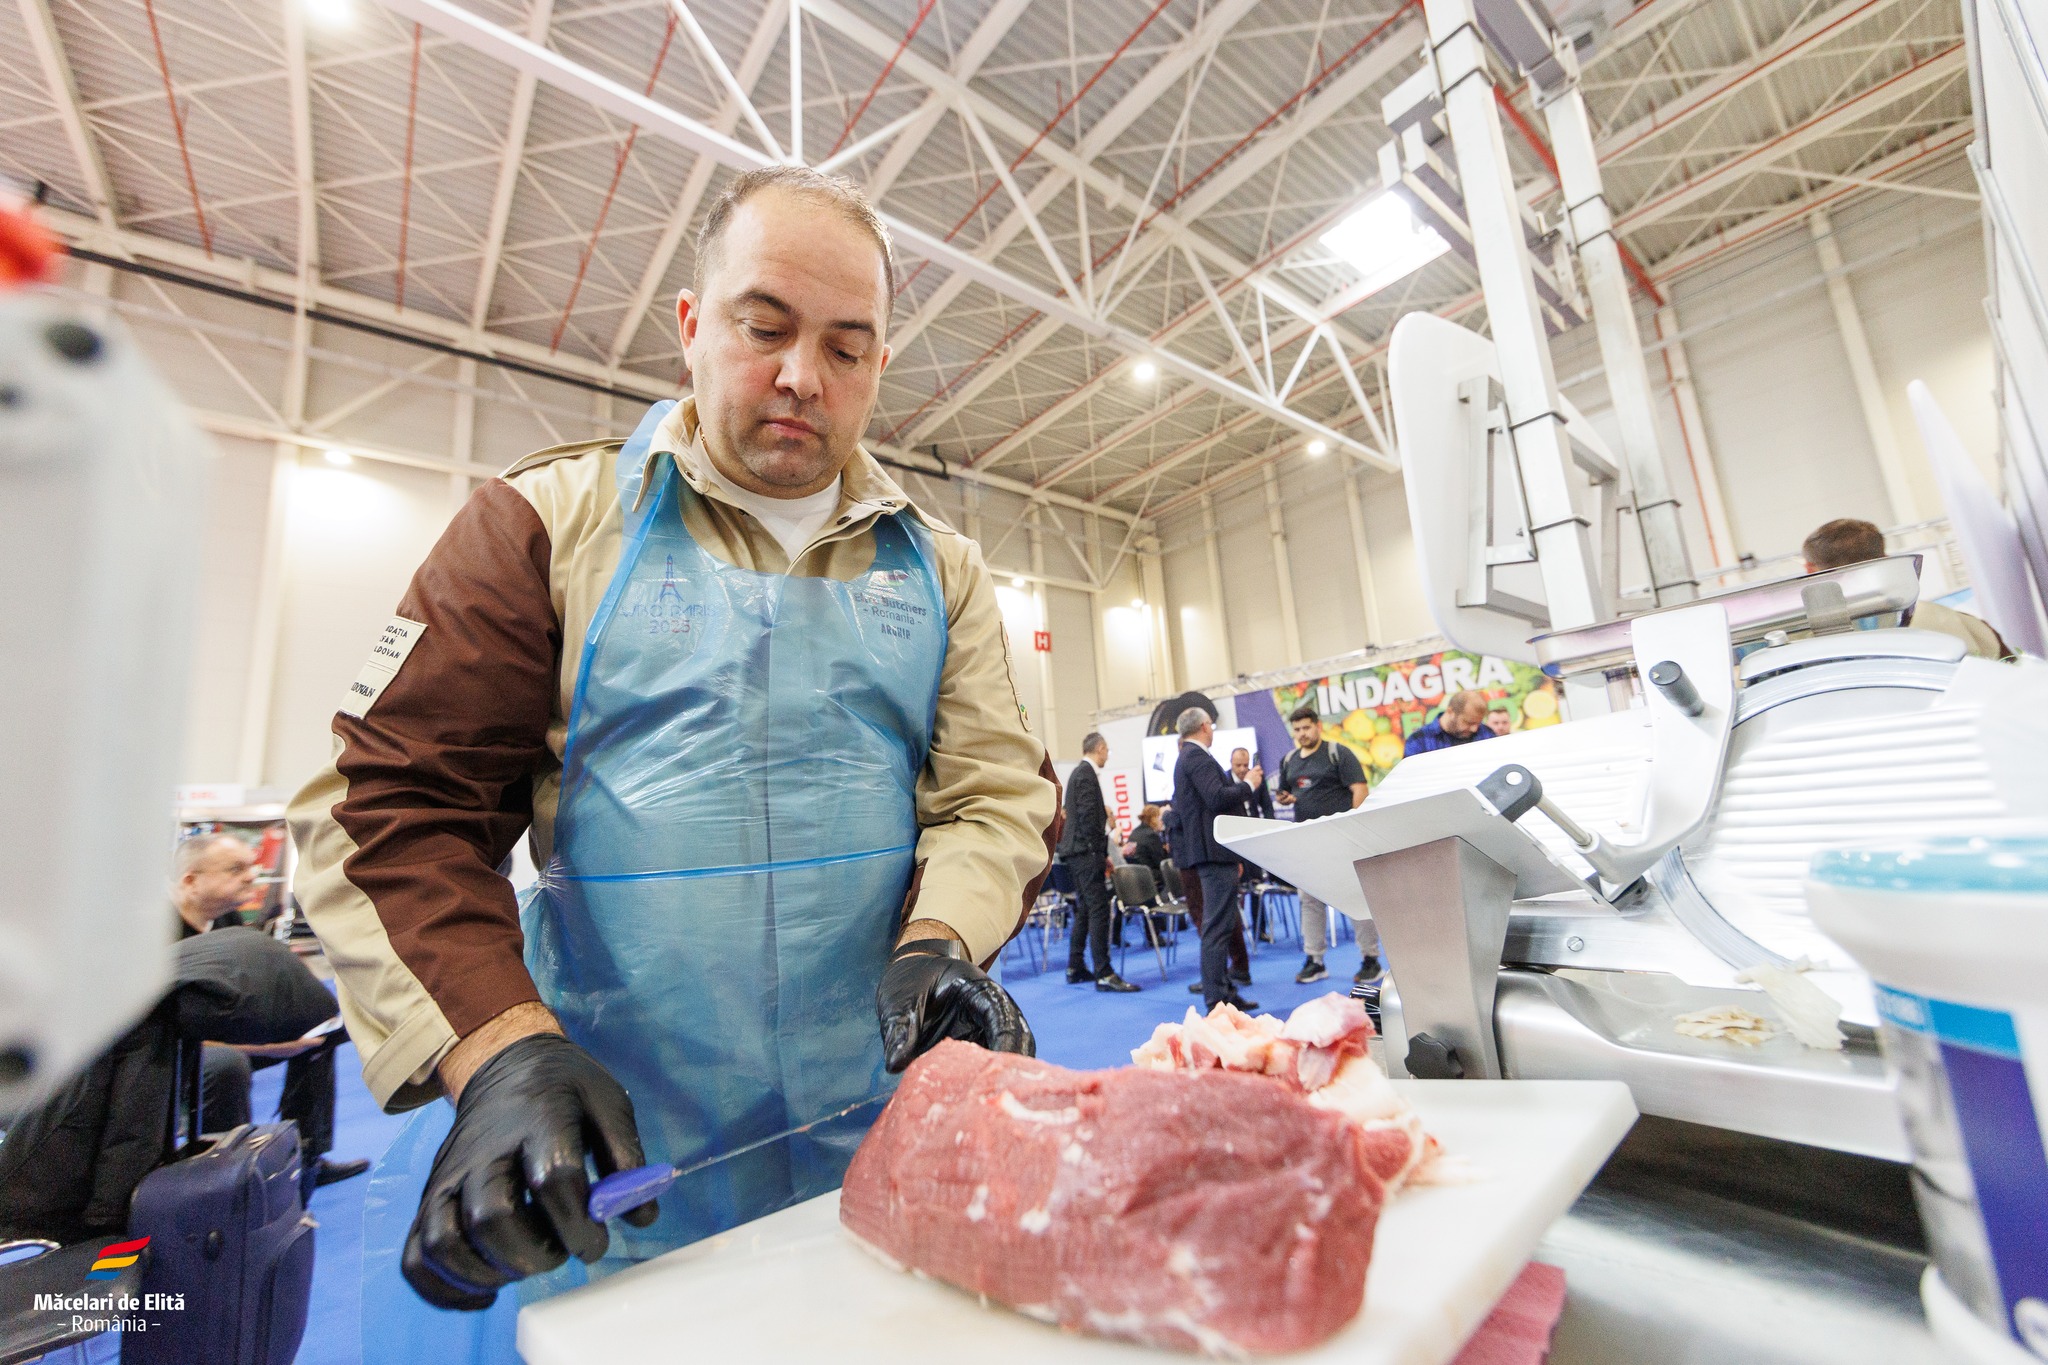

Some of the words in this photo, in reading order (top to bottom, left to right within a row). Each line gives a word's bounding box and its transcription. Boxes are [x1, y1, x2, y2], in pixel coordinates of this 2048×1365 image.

[871, 606, 915, 625] Romania
[881, 596, 927, 616] Butchers
[1037, 634, 1048, 648] H
[1317, 655, 1514, 716] INDAGRA
